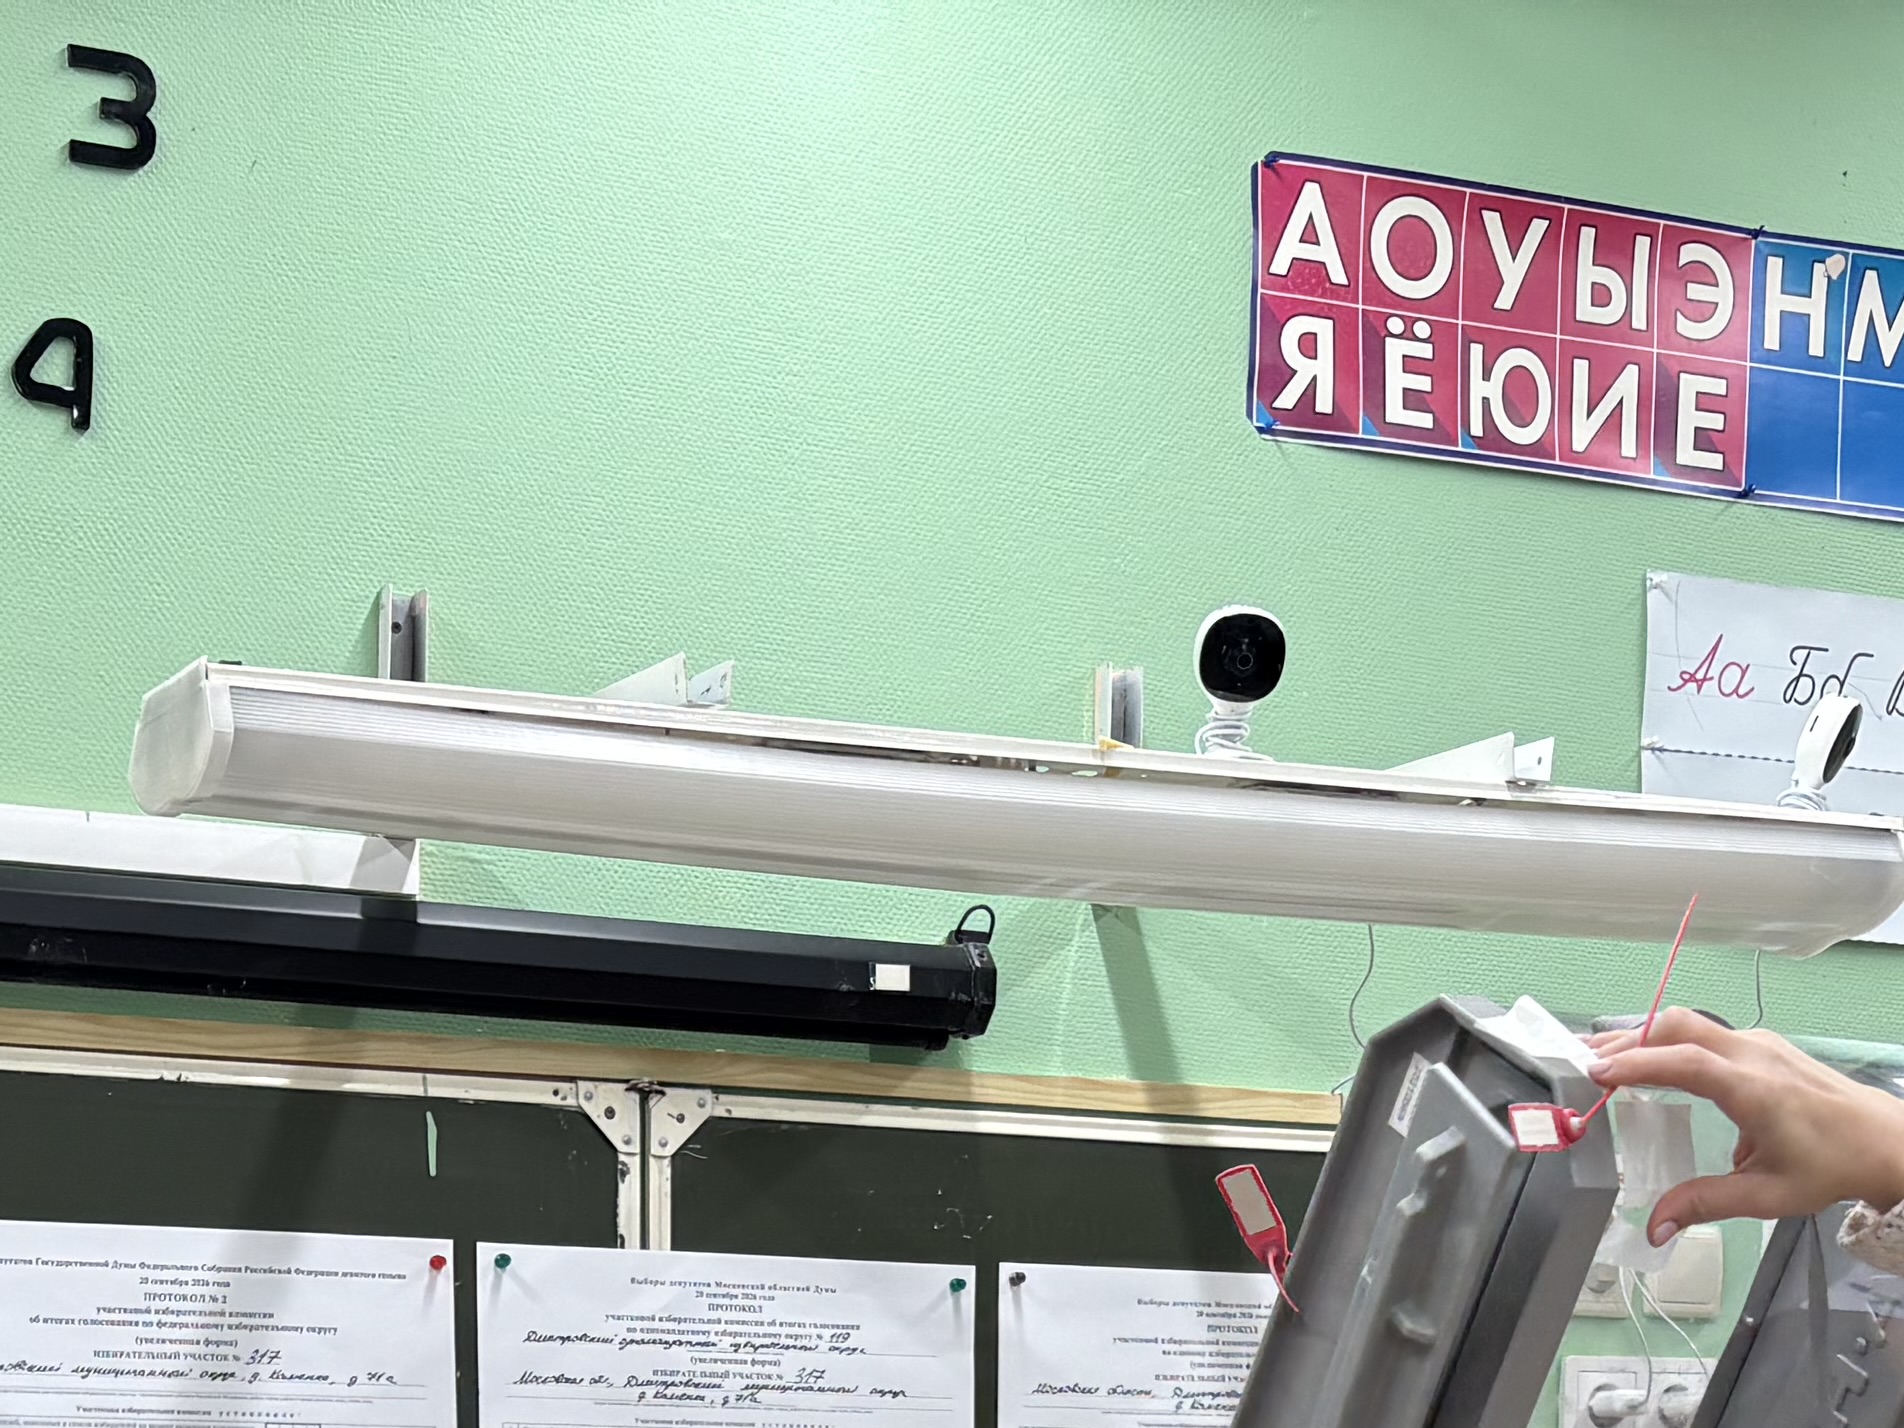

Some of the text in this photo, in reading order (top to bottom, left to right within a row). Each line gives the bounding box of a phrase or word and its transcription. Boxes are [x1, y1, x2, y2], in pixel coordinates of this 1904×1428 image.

[66, 42, 159, 172] 3
[9, 315, 95, 433] 4
[1668, 633, 1754, 699] Аа
